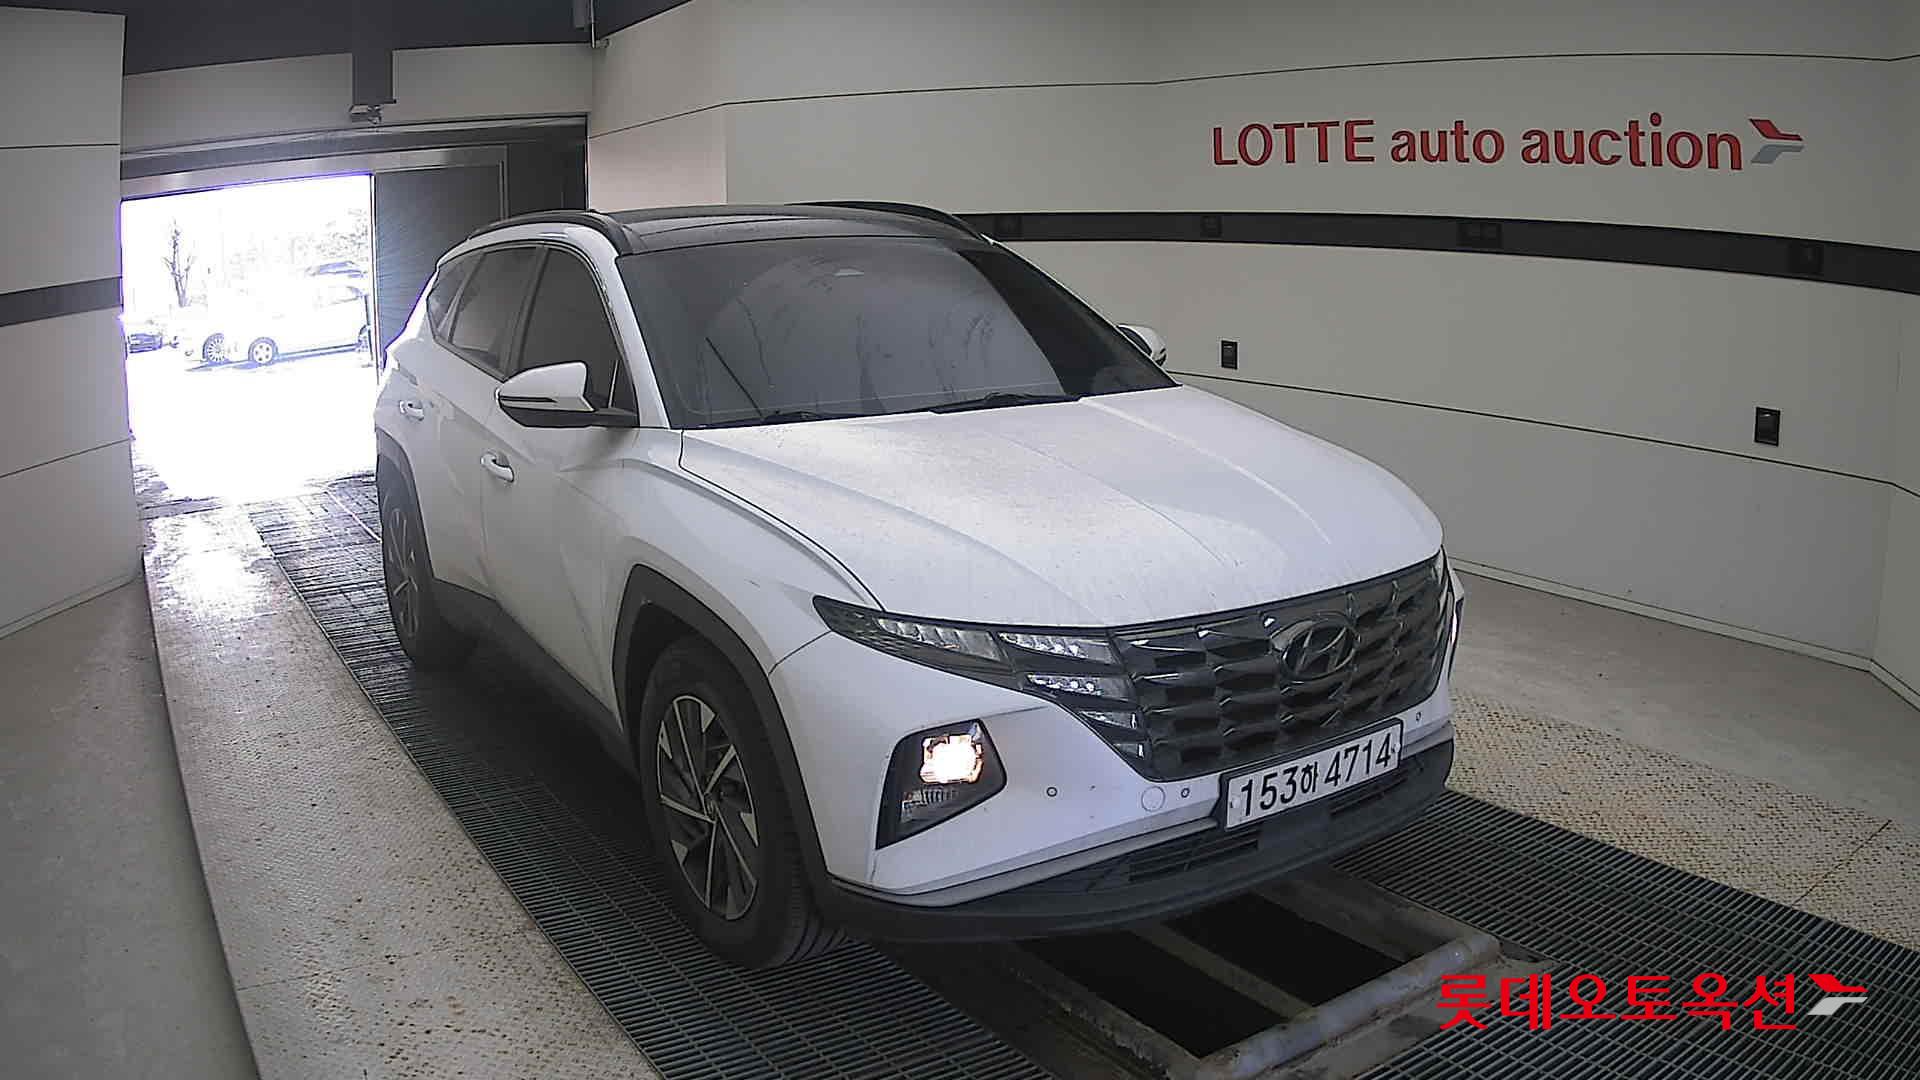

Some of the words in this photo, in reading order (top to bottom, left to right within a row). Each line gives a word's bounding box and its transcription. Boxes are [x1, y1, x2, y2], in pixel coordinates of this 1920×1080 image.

[1212, 119, 1376, 166] LOTTE
[1391, 119, 1505, 164] auto
[1521, 112, 1743, 170] auction
[1241, 761, 1319, 816] 153하
[1324, 733, 1392, 787] 4714
